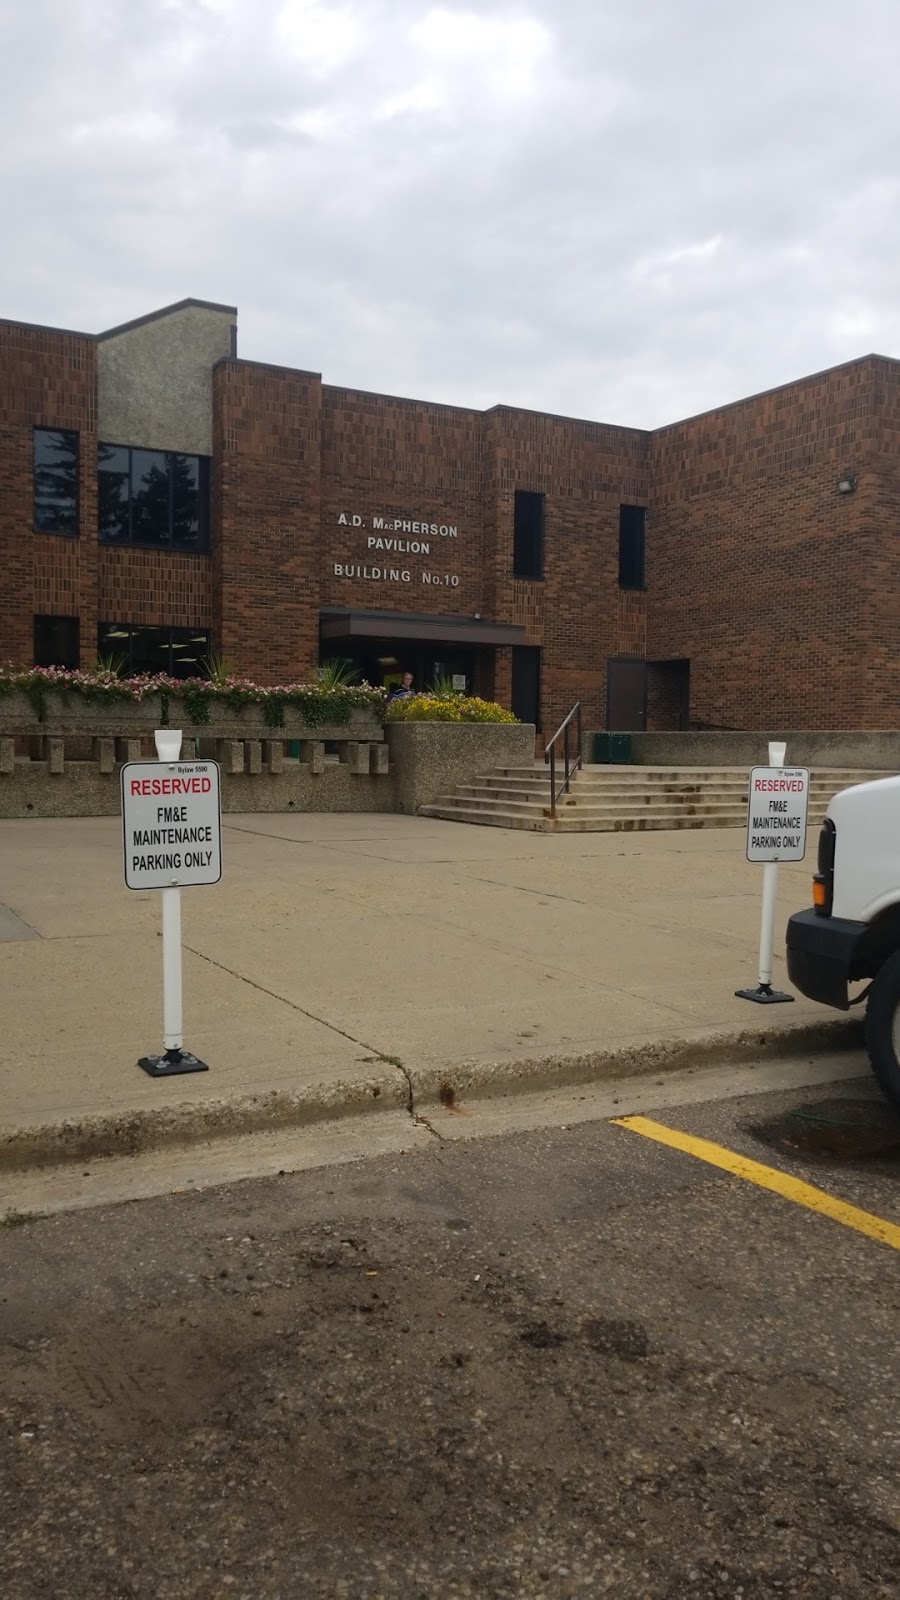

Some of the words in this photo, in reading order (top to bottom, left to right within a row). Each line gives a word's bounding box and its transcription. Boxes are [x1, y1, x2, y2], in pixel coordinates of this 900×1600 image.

[338, 513, 366, 528] A.D.
[367, 536, 430, 554] PAVILION
[334, 564, 411, 582] BUILDING
[422, 572, 459, 586] No.10
[130, 777, 211, 796] RESERVED
[754, 779, 804, 792] RESERVED
[157, 806, 187, 823] FM&E
[769, 800, 788, 812] FM&E
[752, 817, 801, 829] MAINTENANCE
[133, 826, 212, 846] MAINTENANCE
[751, 836, 781, 848] PARKING
[782, 836, 801, 848] ONLY
[132, 853, 181, 871] PARKING
[184, 851, 213, 868] ONLY
